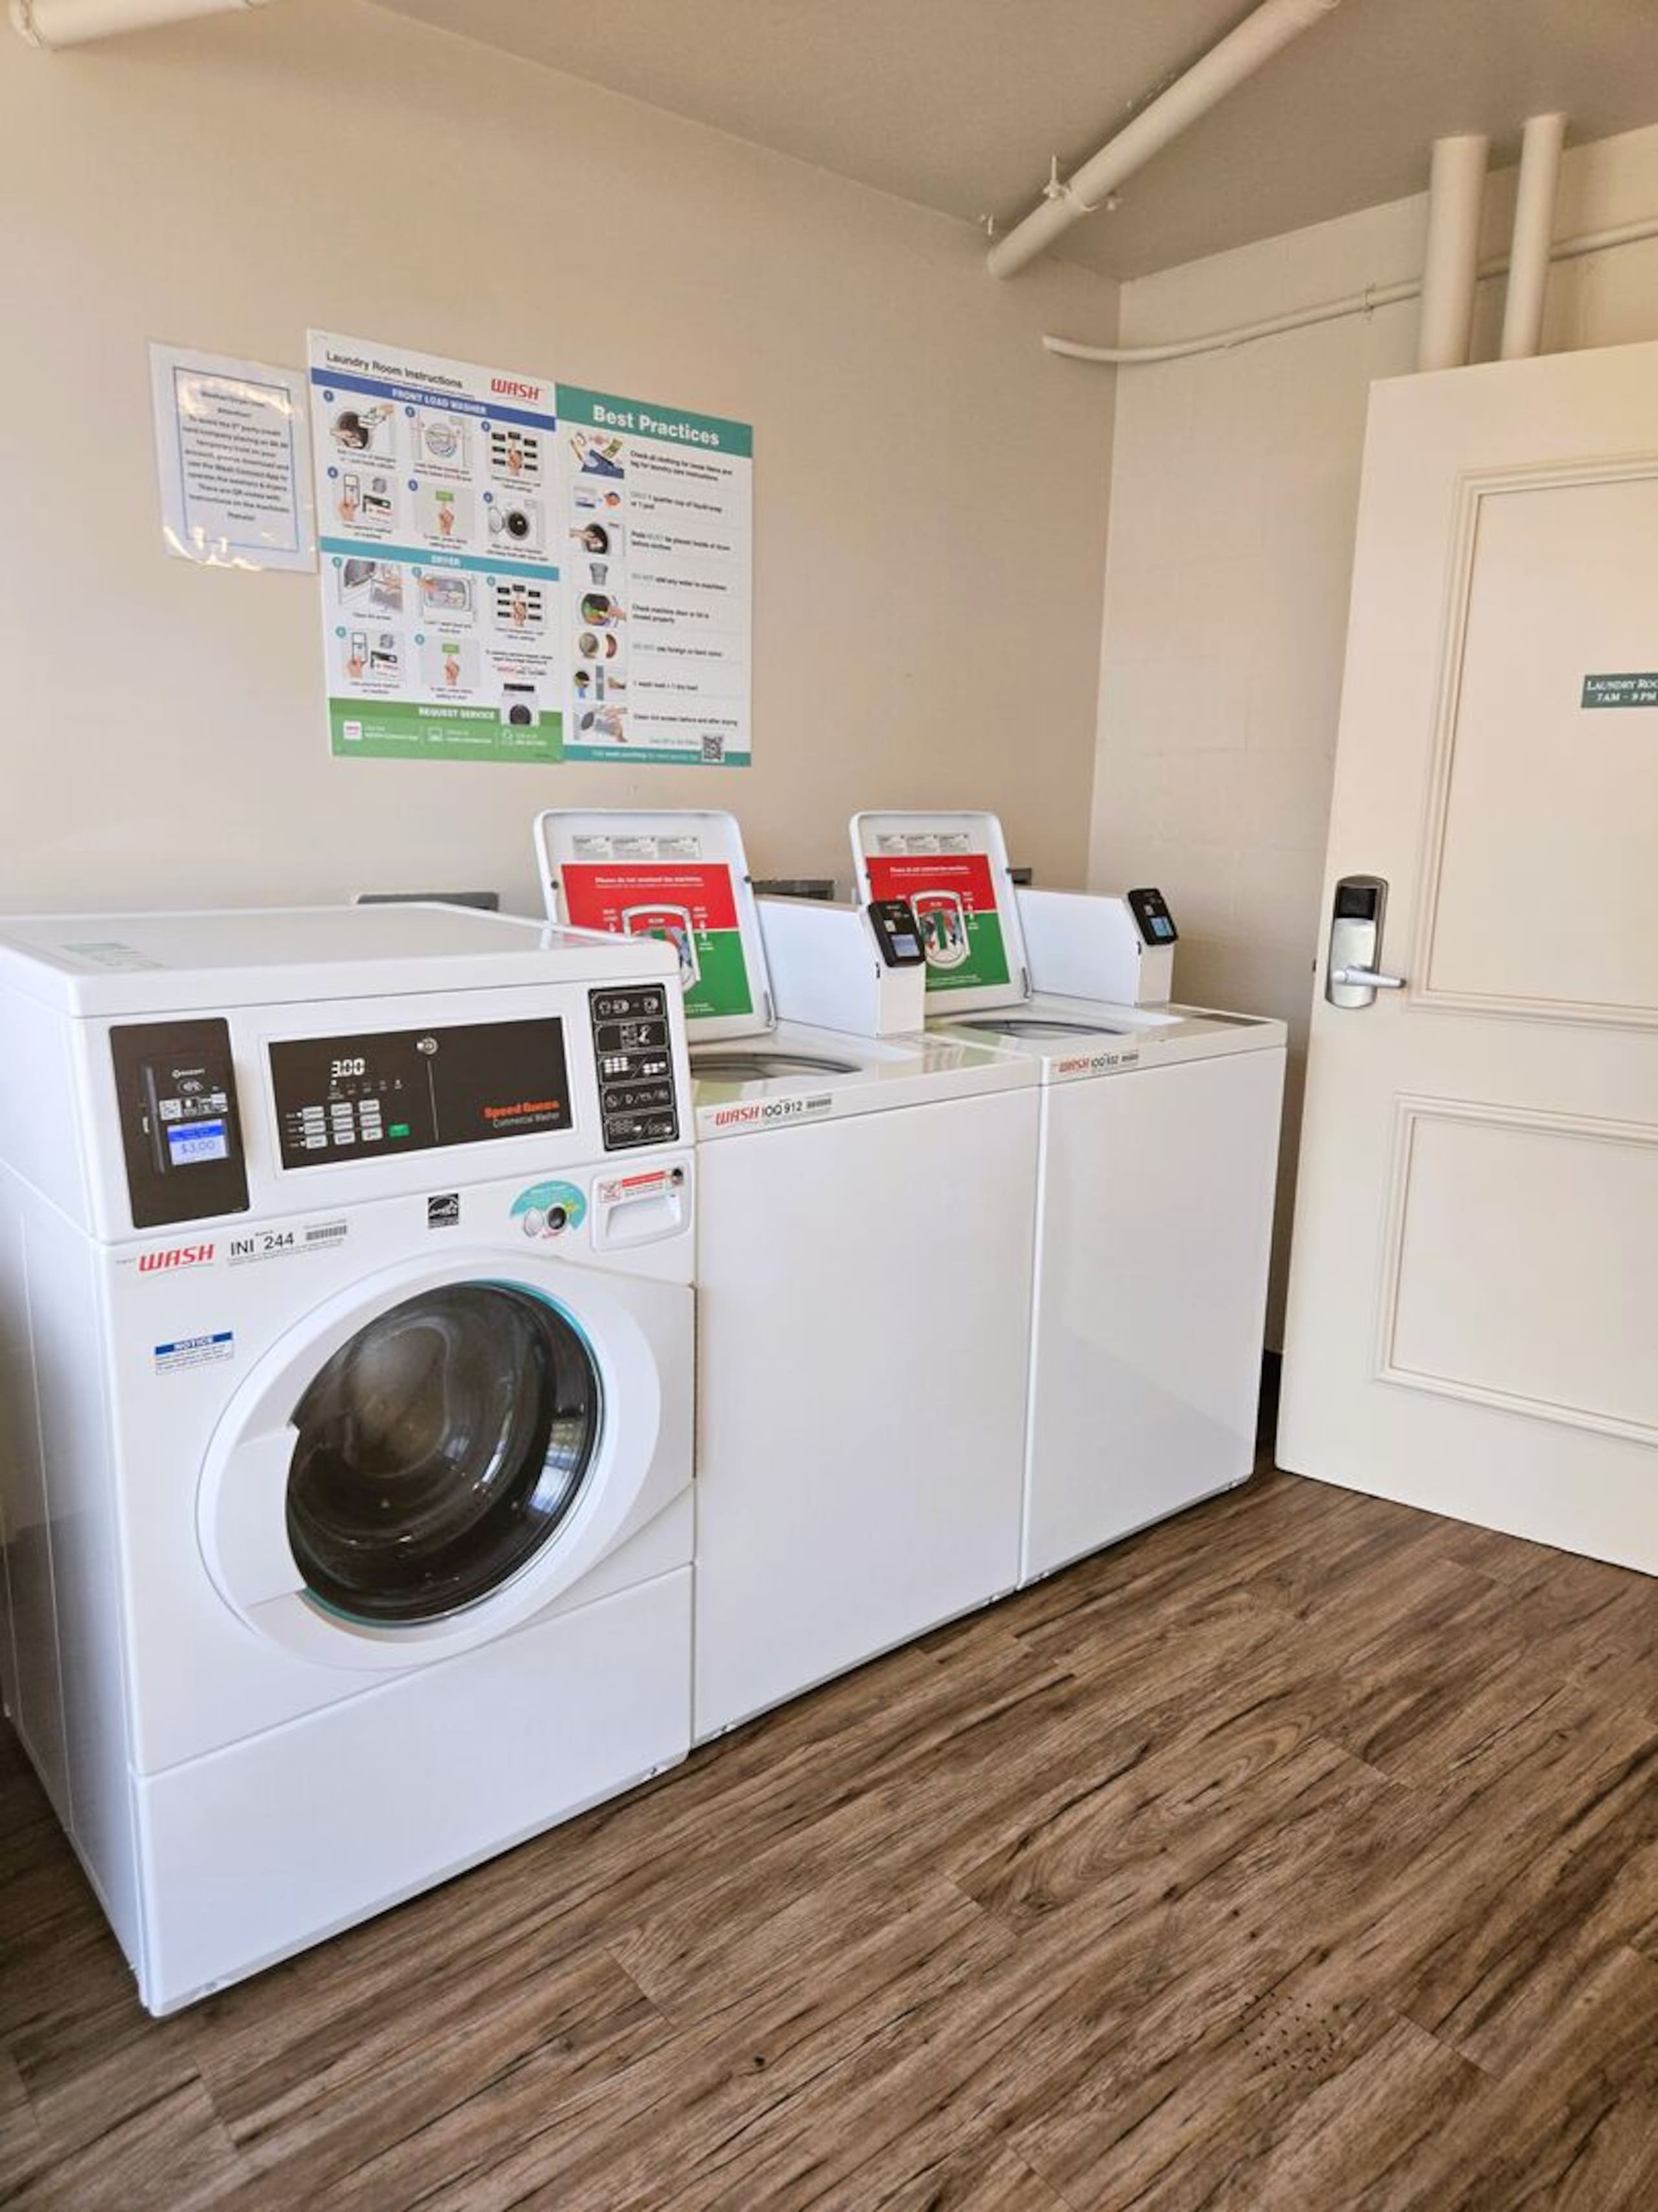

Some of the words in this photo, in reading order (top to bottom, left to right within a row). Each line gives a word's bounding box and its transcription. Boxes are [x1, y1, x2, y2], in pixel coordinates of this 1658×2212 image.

[326, 351, 369, 370] Laundry
[372, 361, 402, 376] Room
[405, 367, 462, 389] Instructions
[392, 388, 422, 403] FRONT
[424, 394, 449, 408] LOAD
[450, 399, 487, 414] WASHER
[491, 378, 539, 401] WASH
[593, 405, 634, 428] Best
[639, 414, 720, 446] Practices
[418, 706, 459, 719] REQUEST
[460, 708, 495, 720] SERVICE
[484, 1103, 522, 1119] Speed
[523, 1100, 560, 1113] Queen
[493, 1116, 534, 1128] Commercial
[535, 1112, 560, 1122] Washer
[716, 1105, 760, 1126] WASH
[784, 1100, 802, 1114] 912
[181, 1140, 216, 1154] $3.00
[139, 1243, 215, 1272] WASH
[230, 1239, 255, 1256] INI
[264, 1232, 295, 1251] 244
